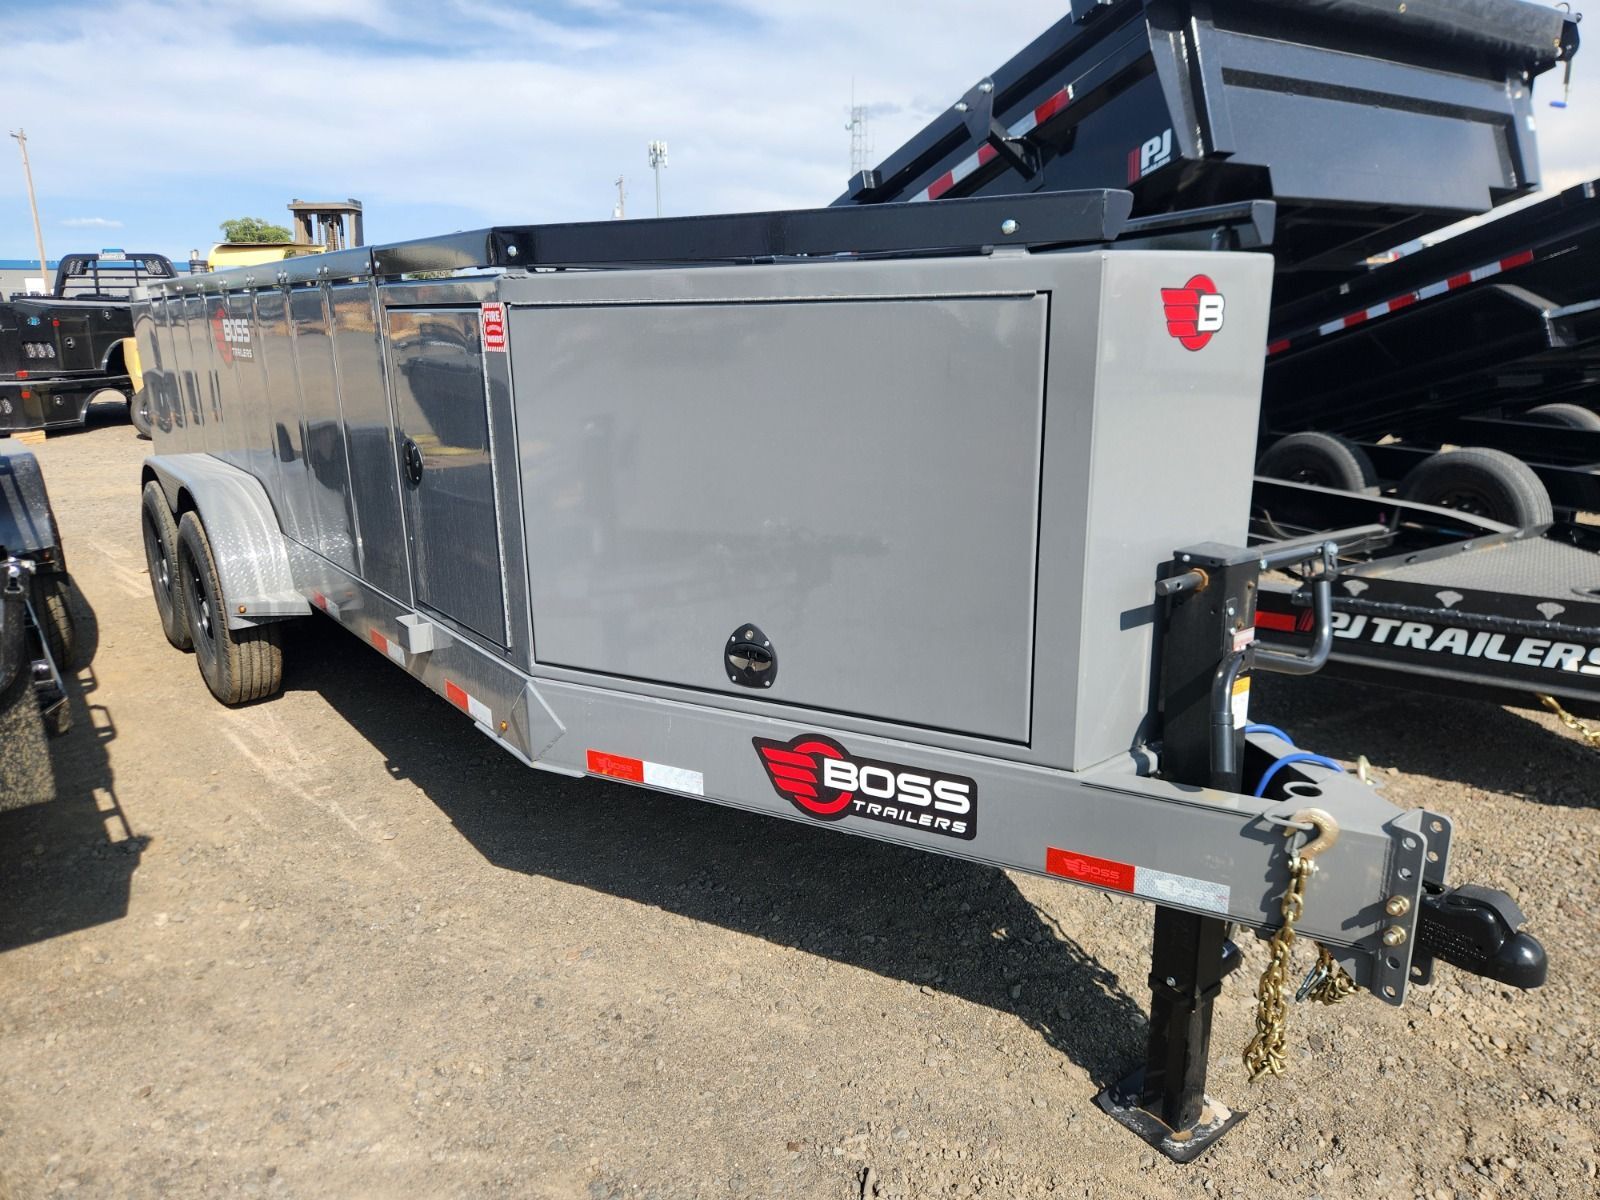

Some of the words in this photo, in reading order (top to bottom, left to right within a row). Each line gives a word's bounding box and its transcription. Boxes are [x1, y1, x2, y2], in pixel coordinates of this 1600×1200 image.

[1140, 128, 1172, 171] PJ
[485, 310, 501, 322] FIRE
[1198, 294, 1225, 331] B
[222, 318, 250, 343] BOSS
[823, 757, 971, 815] BOSS
[853, 799, 968, 834] TRAILERS
[1080, 863, 1120, 880] BOSS
